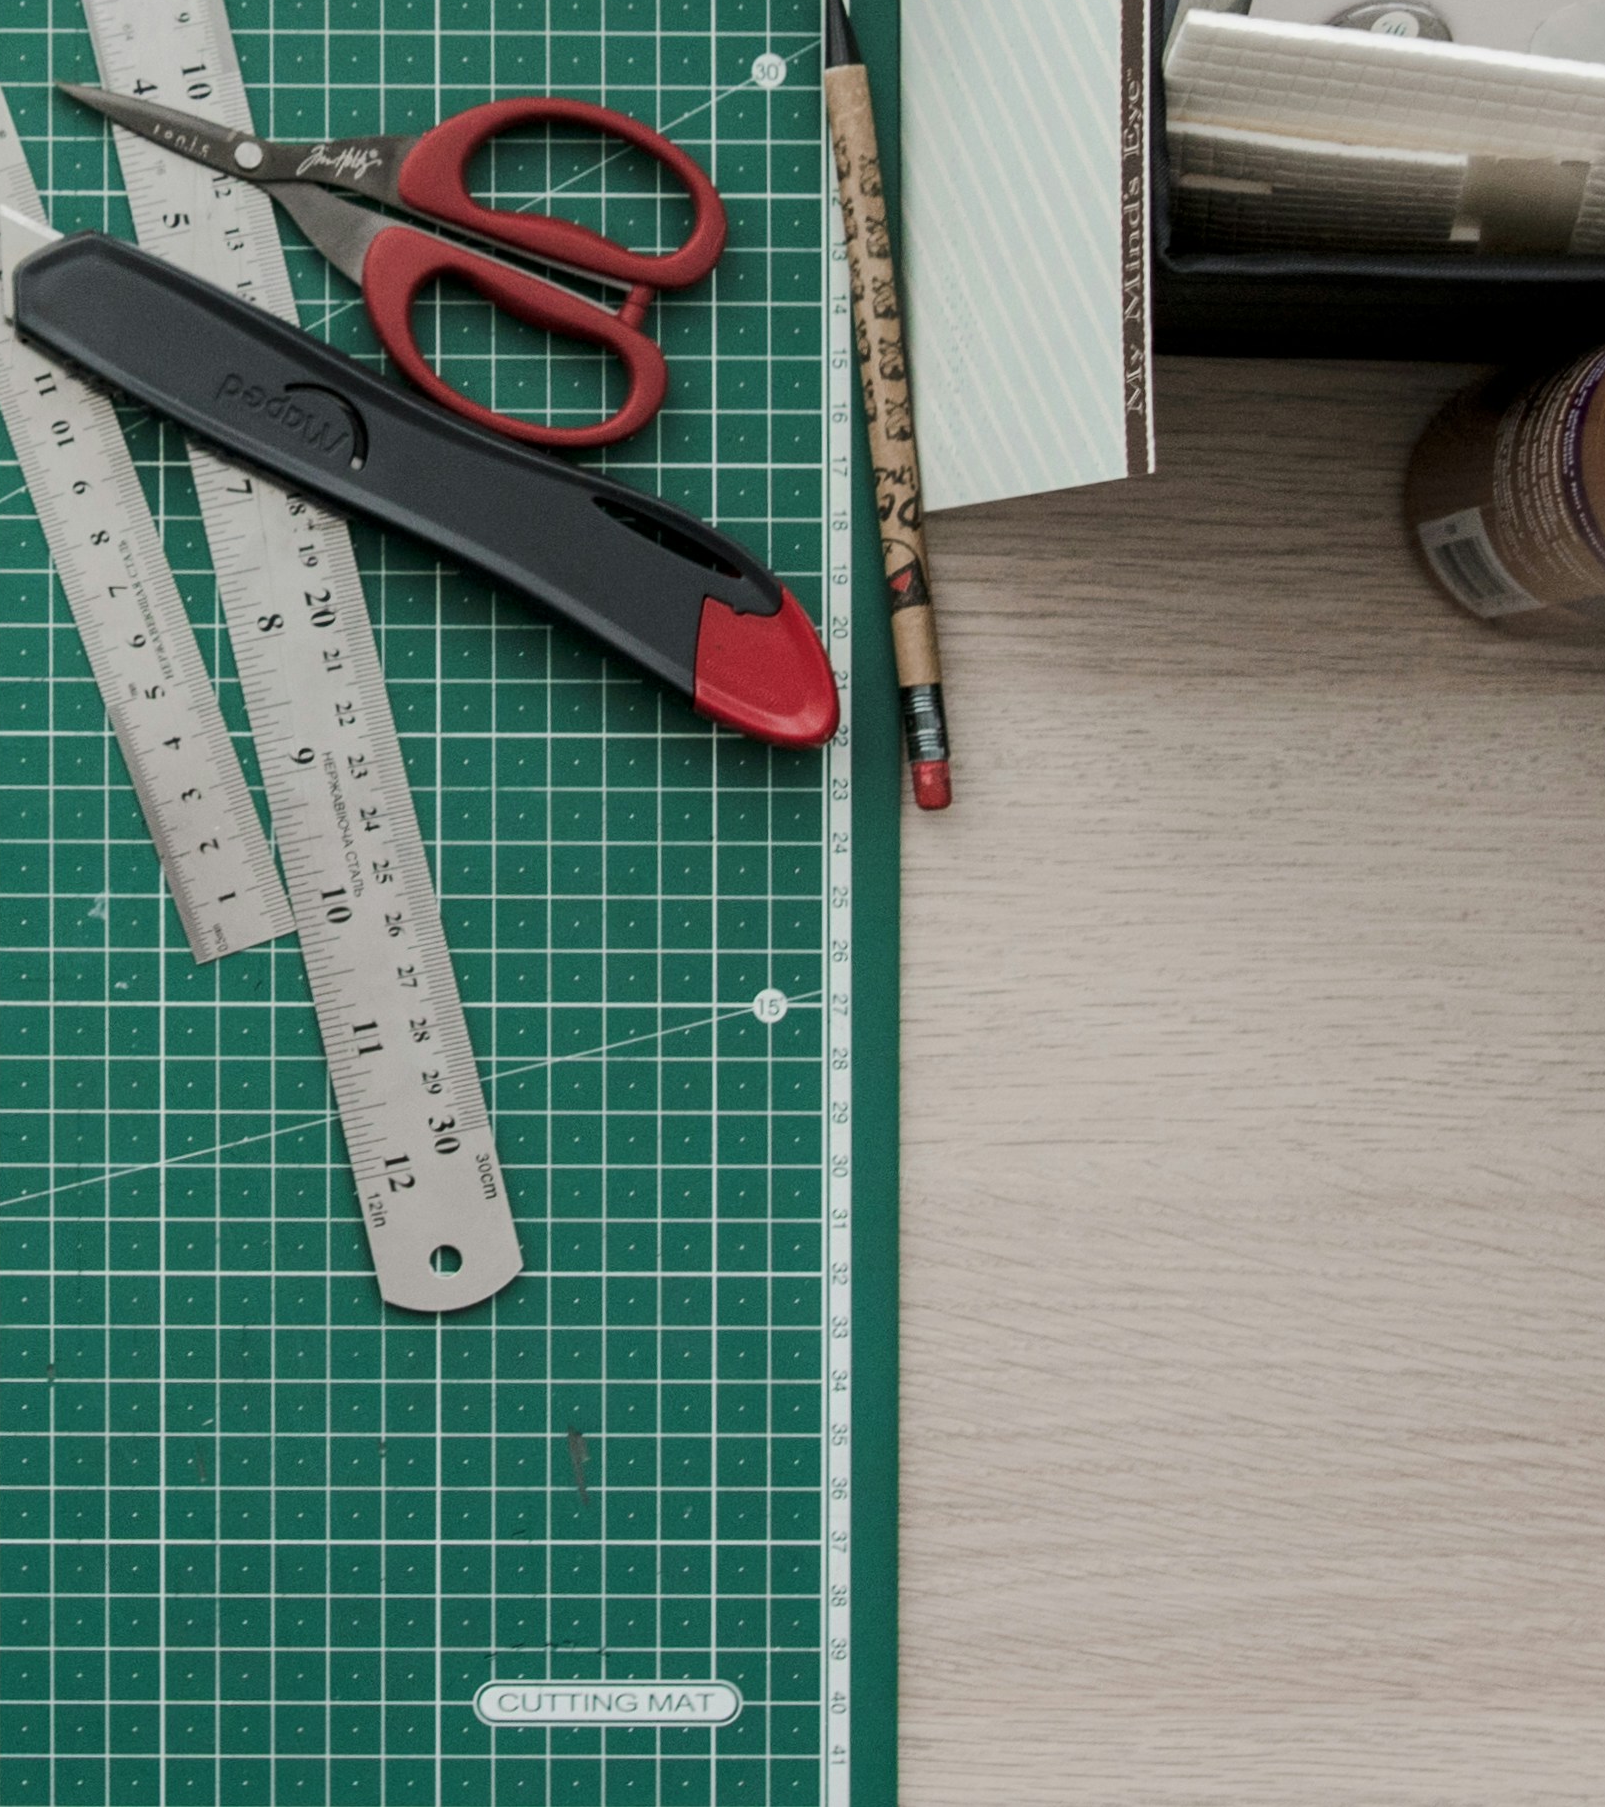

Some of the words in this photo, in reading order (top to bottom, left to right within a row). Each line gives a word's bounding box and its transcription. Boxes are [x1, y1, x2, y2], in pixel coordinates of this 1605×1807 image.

[181, 62, 213, 100] 10
[1123, 176, 1143, 323] Mind's
[1124, 347, 1145, 418] My
[215, 372, 352, 455] Maped
[33, 372, 58, 397] 11
[50, 419, 75, 448] 10
[145, 684, 165, 701] 5
[298, 543, 319, 569] 19
[303, 589, 336, 628] 20
[132, 78, 159, 96] 4
[162, 211, 191, 230] 5
[226, 479, 253, 495] 7
[257, 613, 285, 633] 8
[291, 747, 315, 766] 9
[320, 886, 353, 925] 10
[351, 1018, 384, 1058] 11
[384, 1153, 415, 1193] 12
[335, 700, 356, 727] 22
[831, 779, 848, 802] 23
[359, 807, 381, 833] 24
[372, 858, 393, 886] 25
[831, 994, 848, 1016] 27
[428, 1114, 461, 1156] 30
[475, 1152, 498, 1201] 30cm
[366, 1191, 387, 1230] 12in
[831, 1263, 848, 1285] 32
[831, 1423, 848, 1446] 35
[831, 1638, 848, 1661] 39
[497, 1691, 639, 1715] CUTTING
[648, 1691, 716, 1715] MAT
